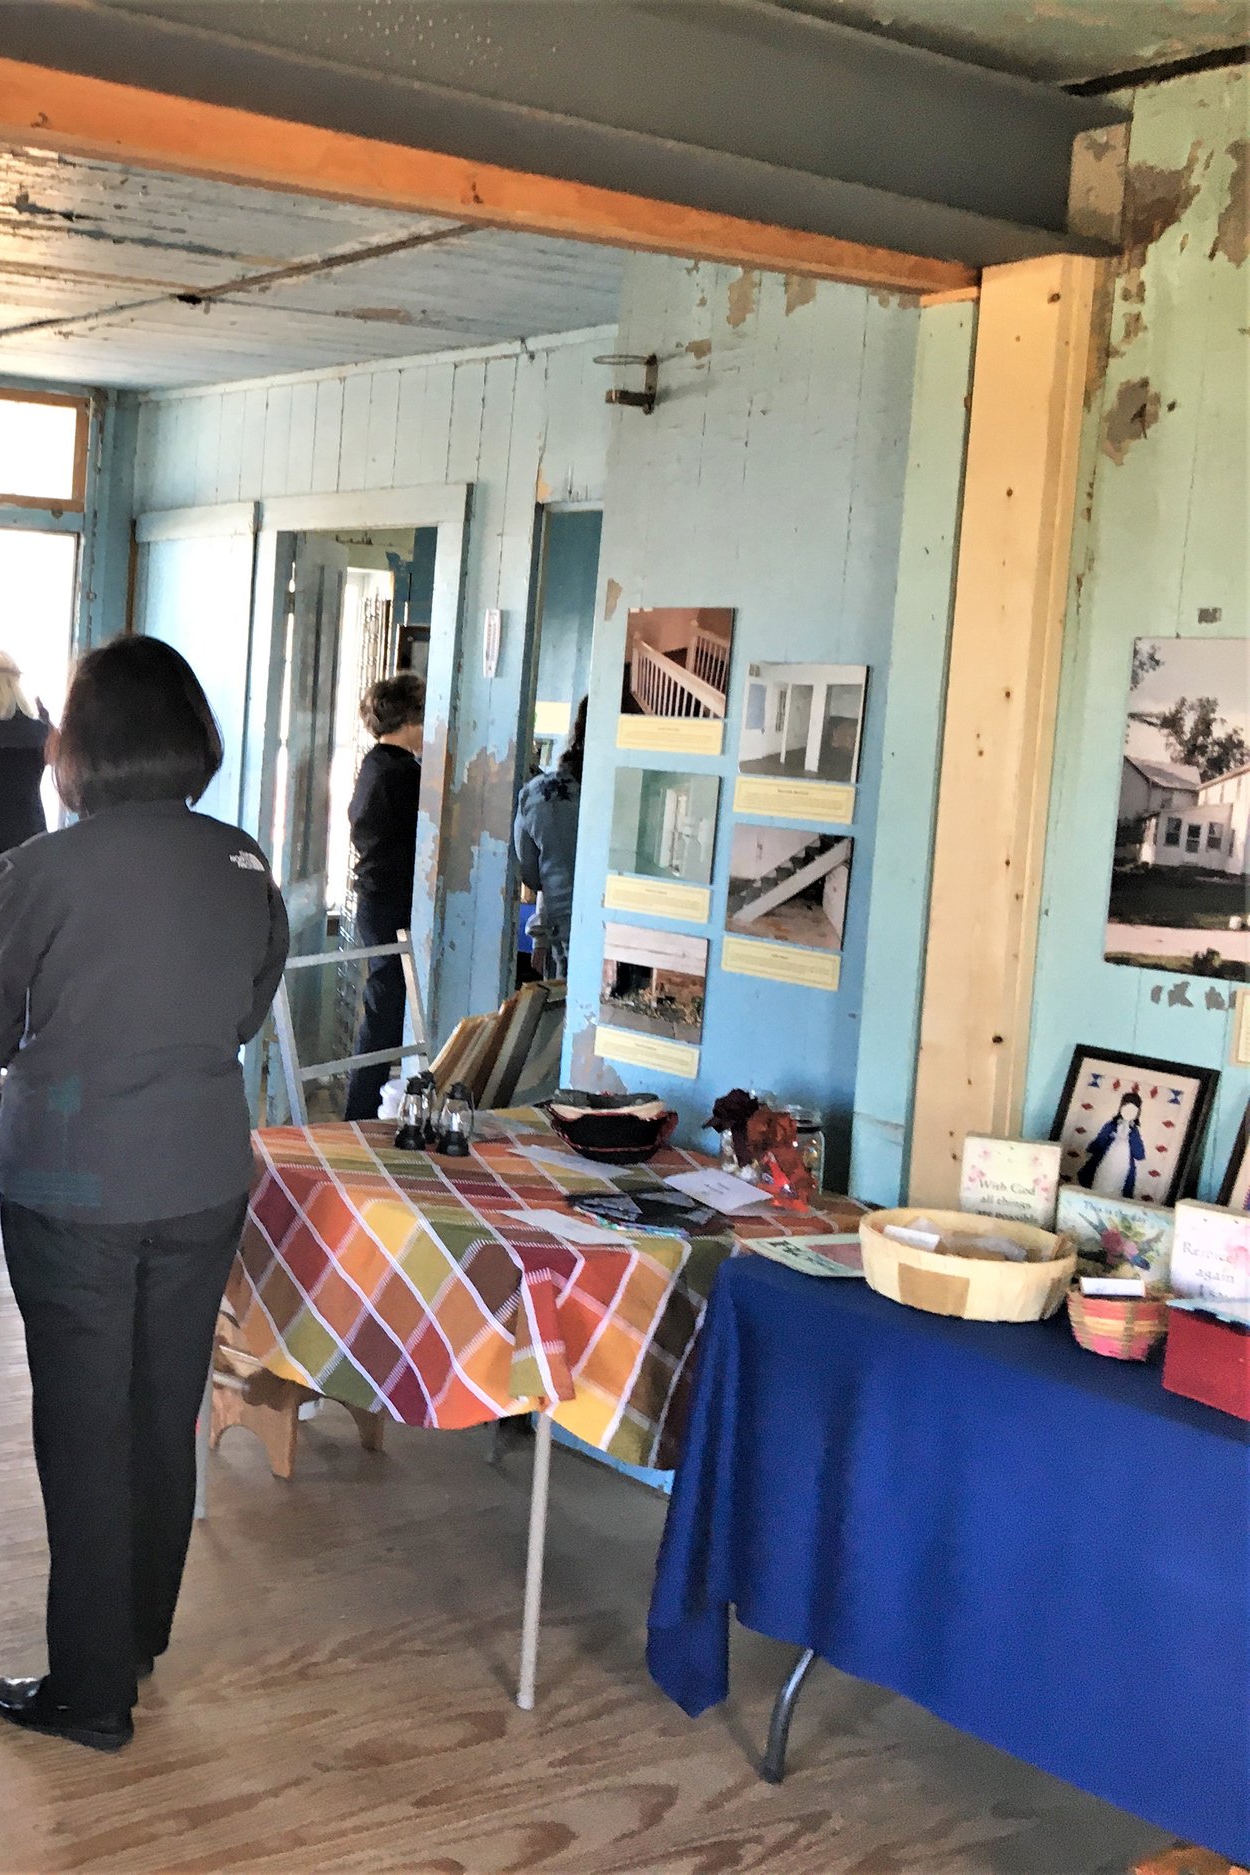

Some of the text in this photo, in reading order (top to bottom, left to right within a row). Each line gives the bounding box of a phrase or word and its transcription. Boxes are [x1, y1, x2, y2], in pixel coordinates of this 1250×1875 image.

[978, 1179, 1037, 1197] With God
[980, 1195, 994, 1205] all
